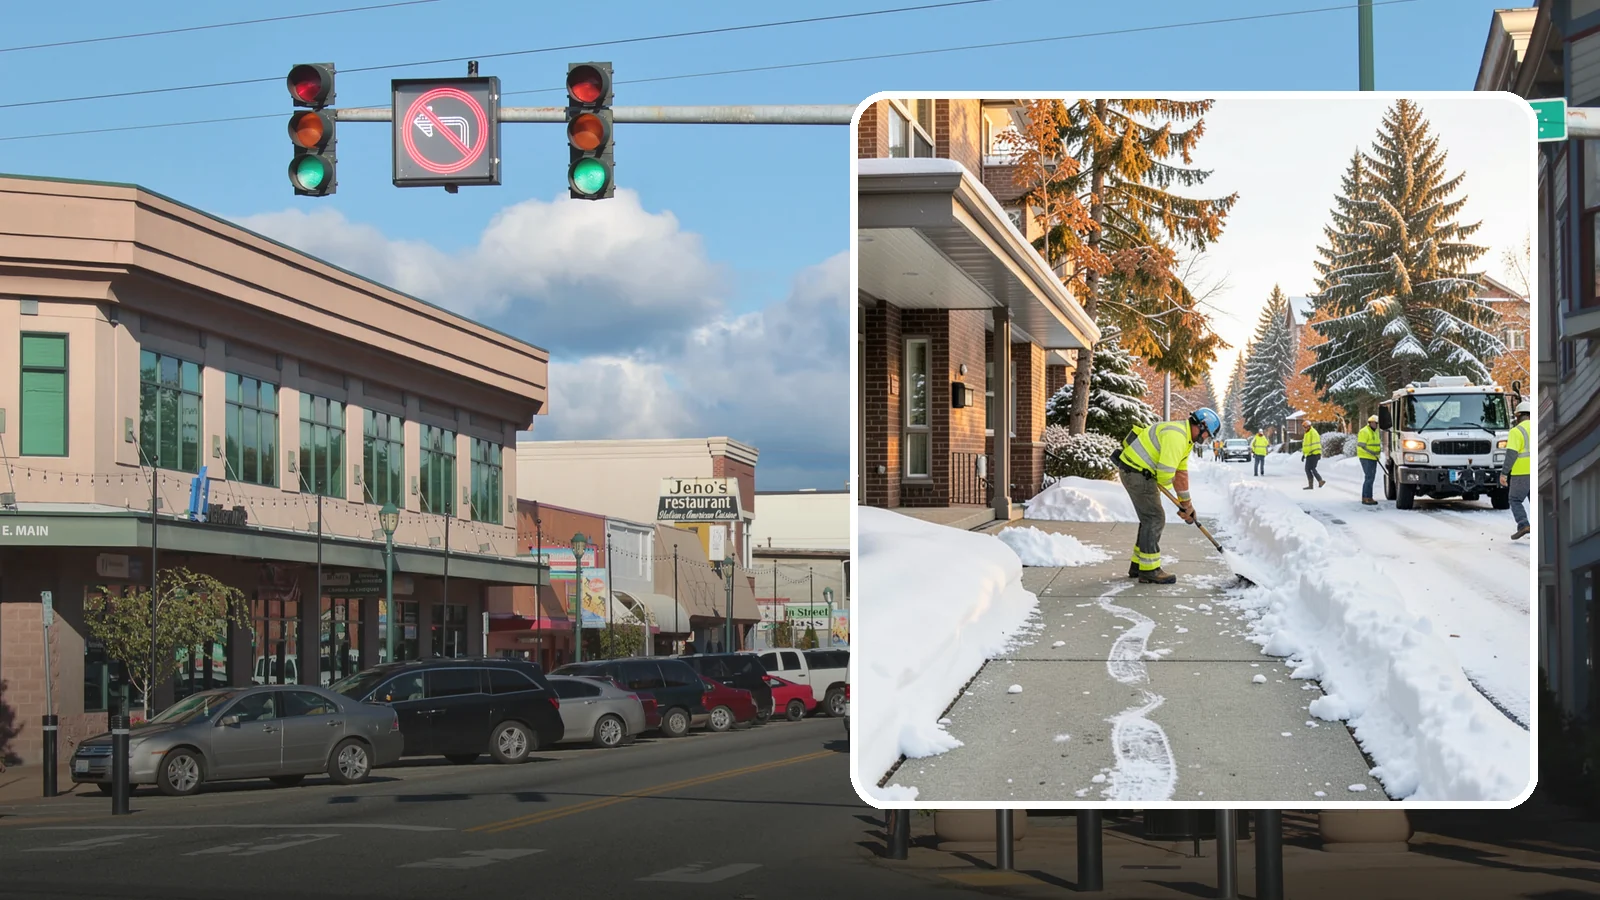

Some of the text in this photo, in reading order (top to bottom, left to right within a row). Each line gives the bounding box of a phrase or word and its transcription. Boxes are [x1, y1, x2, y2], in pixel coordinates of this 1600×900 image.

[670, 480, 727, 494] Jeno's
[665, 496, 731, 509] restaurant
[658, 509, 682, 519] Italian
[686, 510, 715, 519] American
[715, 509, 737, 518] Cuisine
[2, 525, 49, 536] E. MAIN
[797, 608, 828, 616] Street
